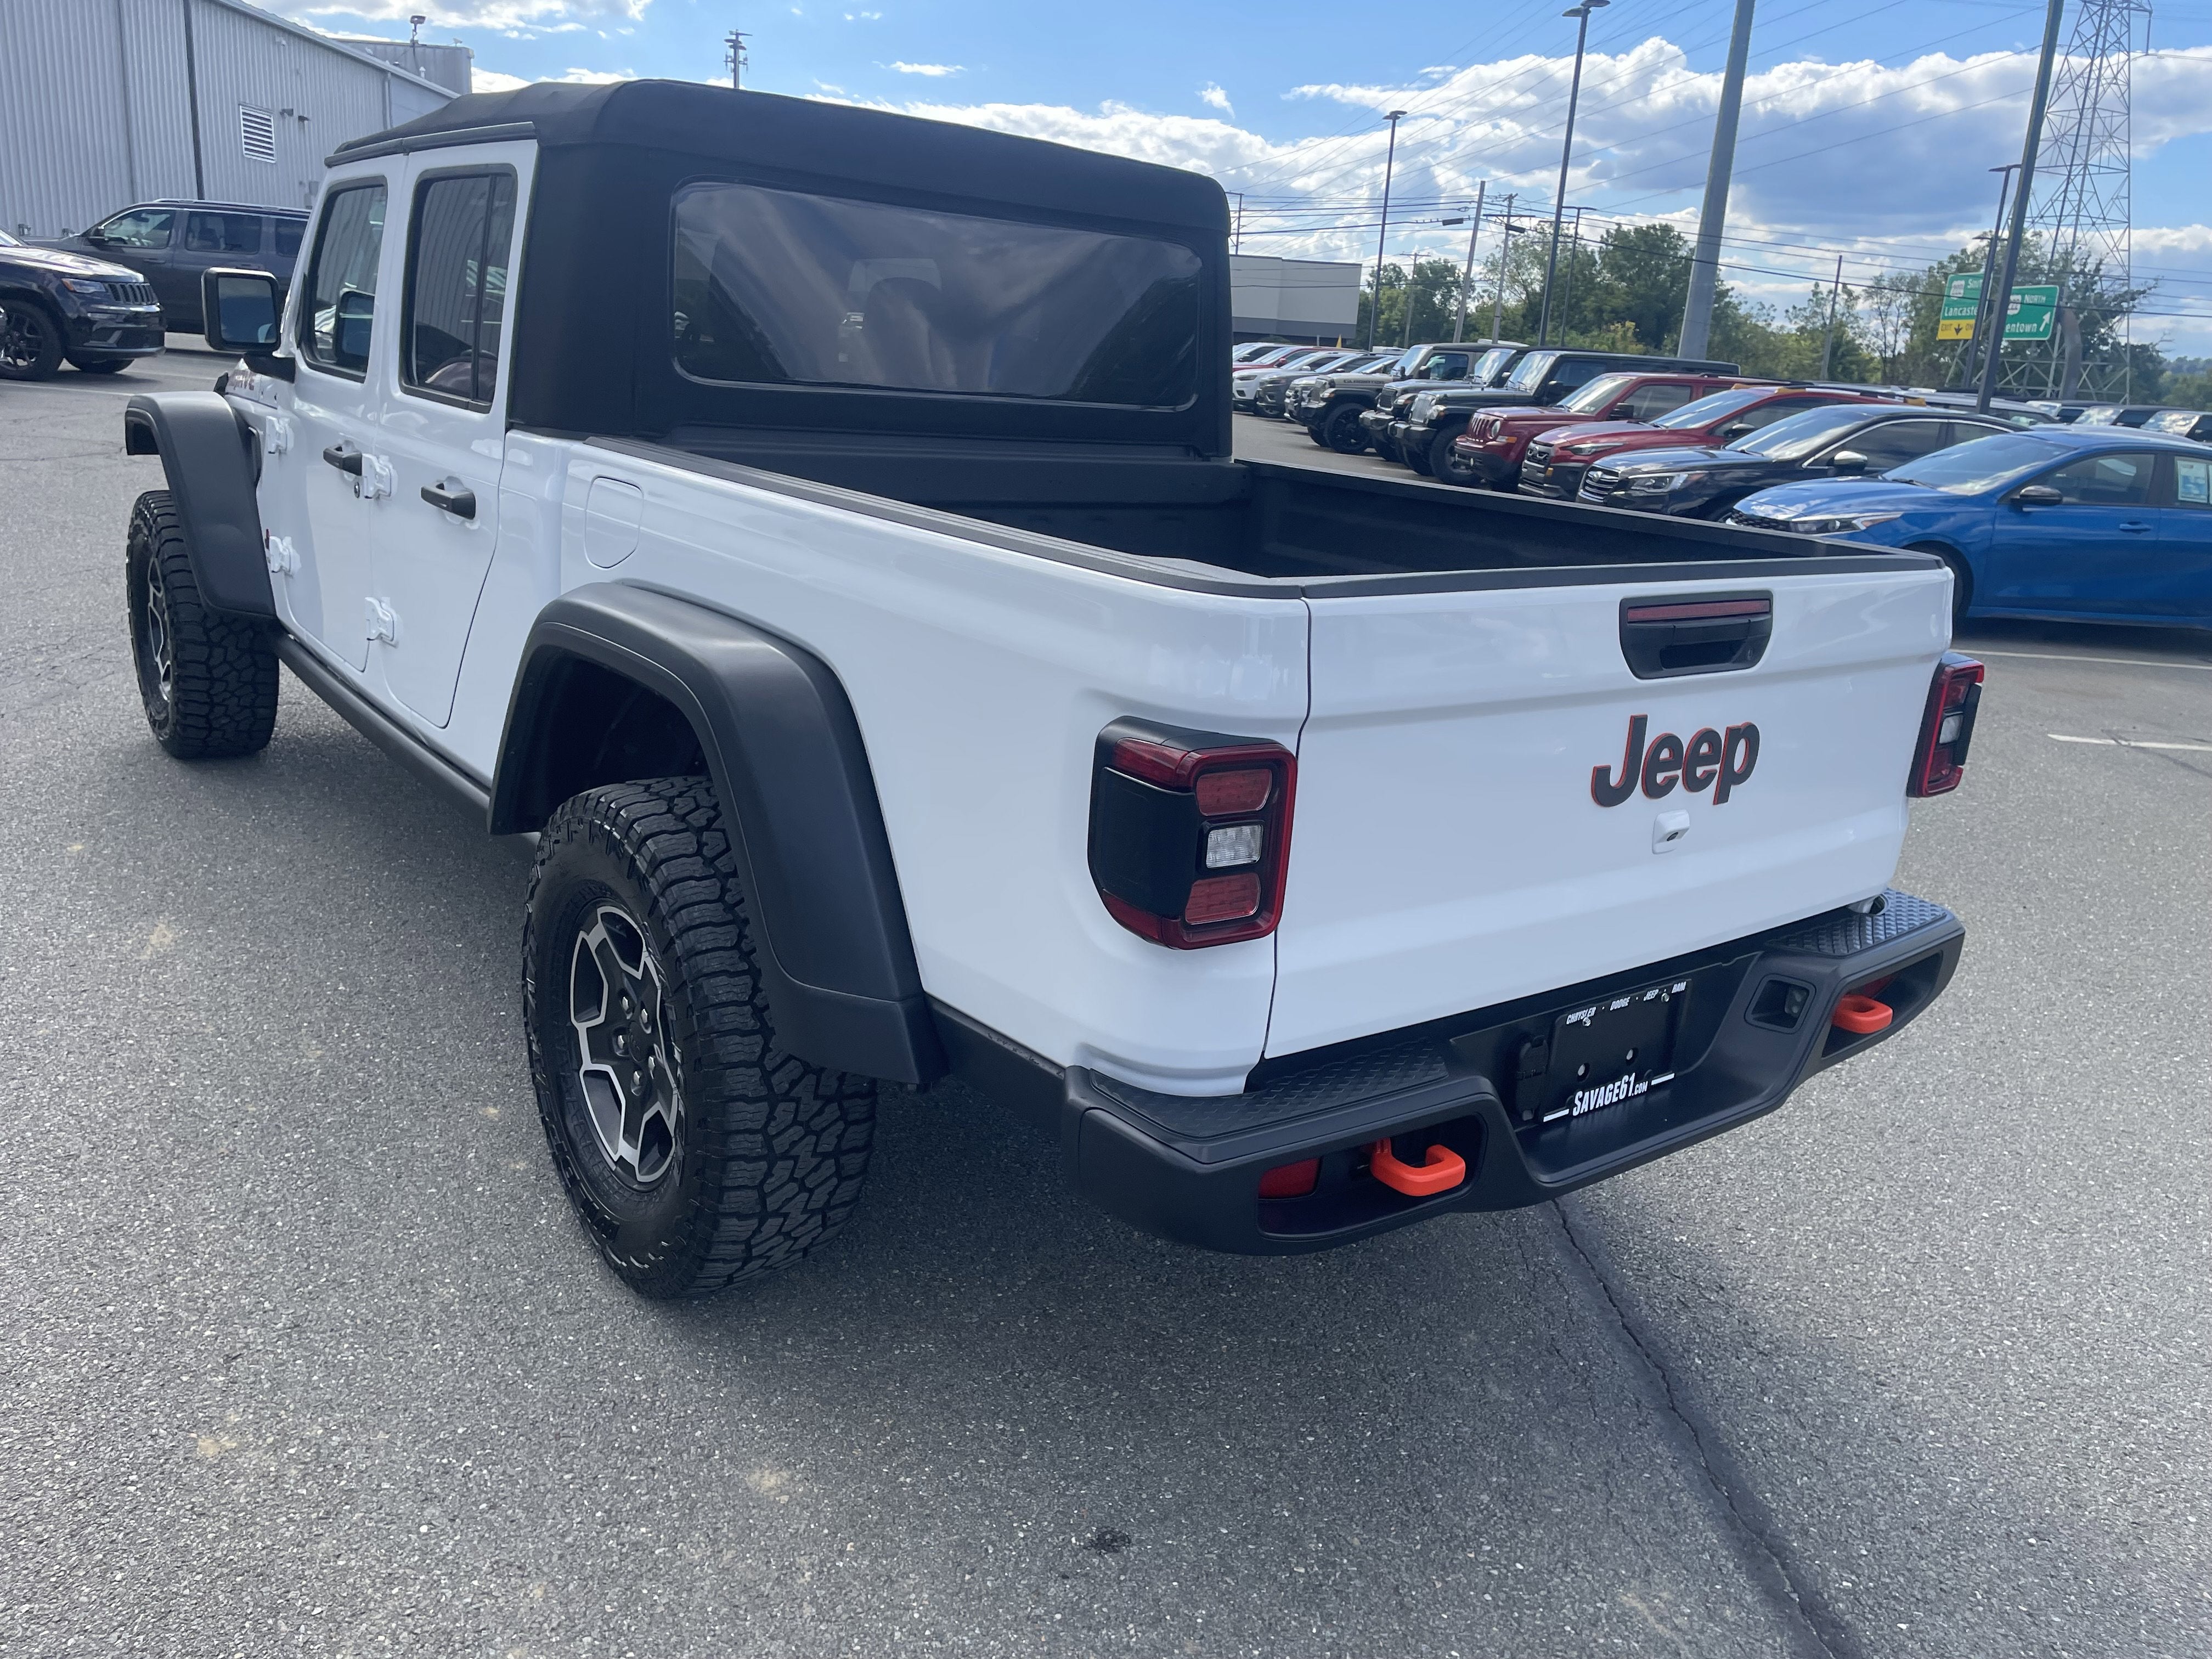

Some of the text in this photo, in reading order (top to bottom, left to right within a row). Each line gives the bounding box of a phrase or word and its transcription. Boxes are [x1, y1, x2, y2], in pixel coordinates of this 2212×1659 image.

[1945, 306, 1977, 316] Lancaste
[2006, 323, 2037, 332] entown
[1591, 714, 1760, 808] Jeep
[1566, 981, 1686, 1025] CHRYSLER DODGE JEEP RAM
[1572, 1072, 1648, 1116] SAVAGE61.COM
